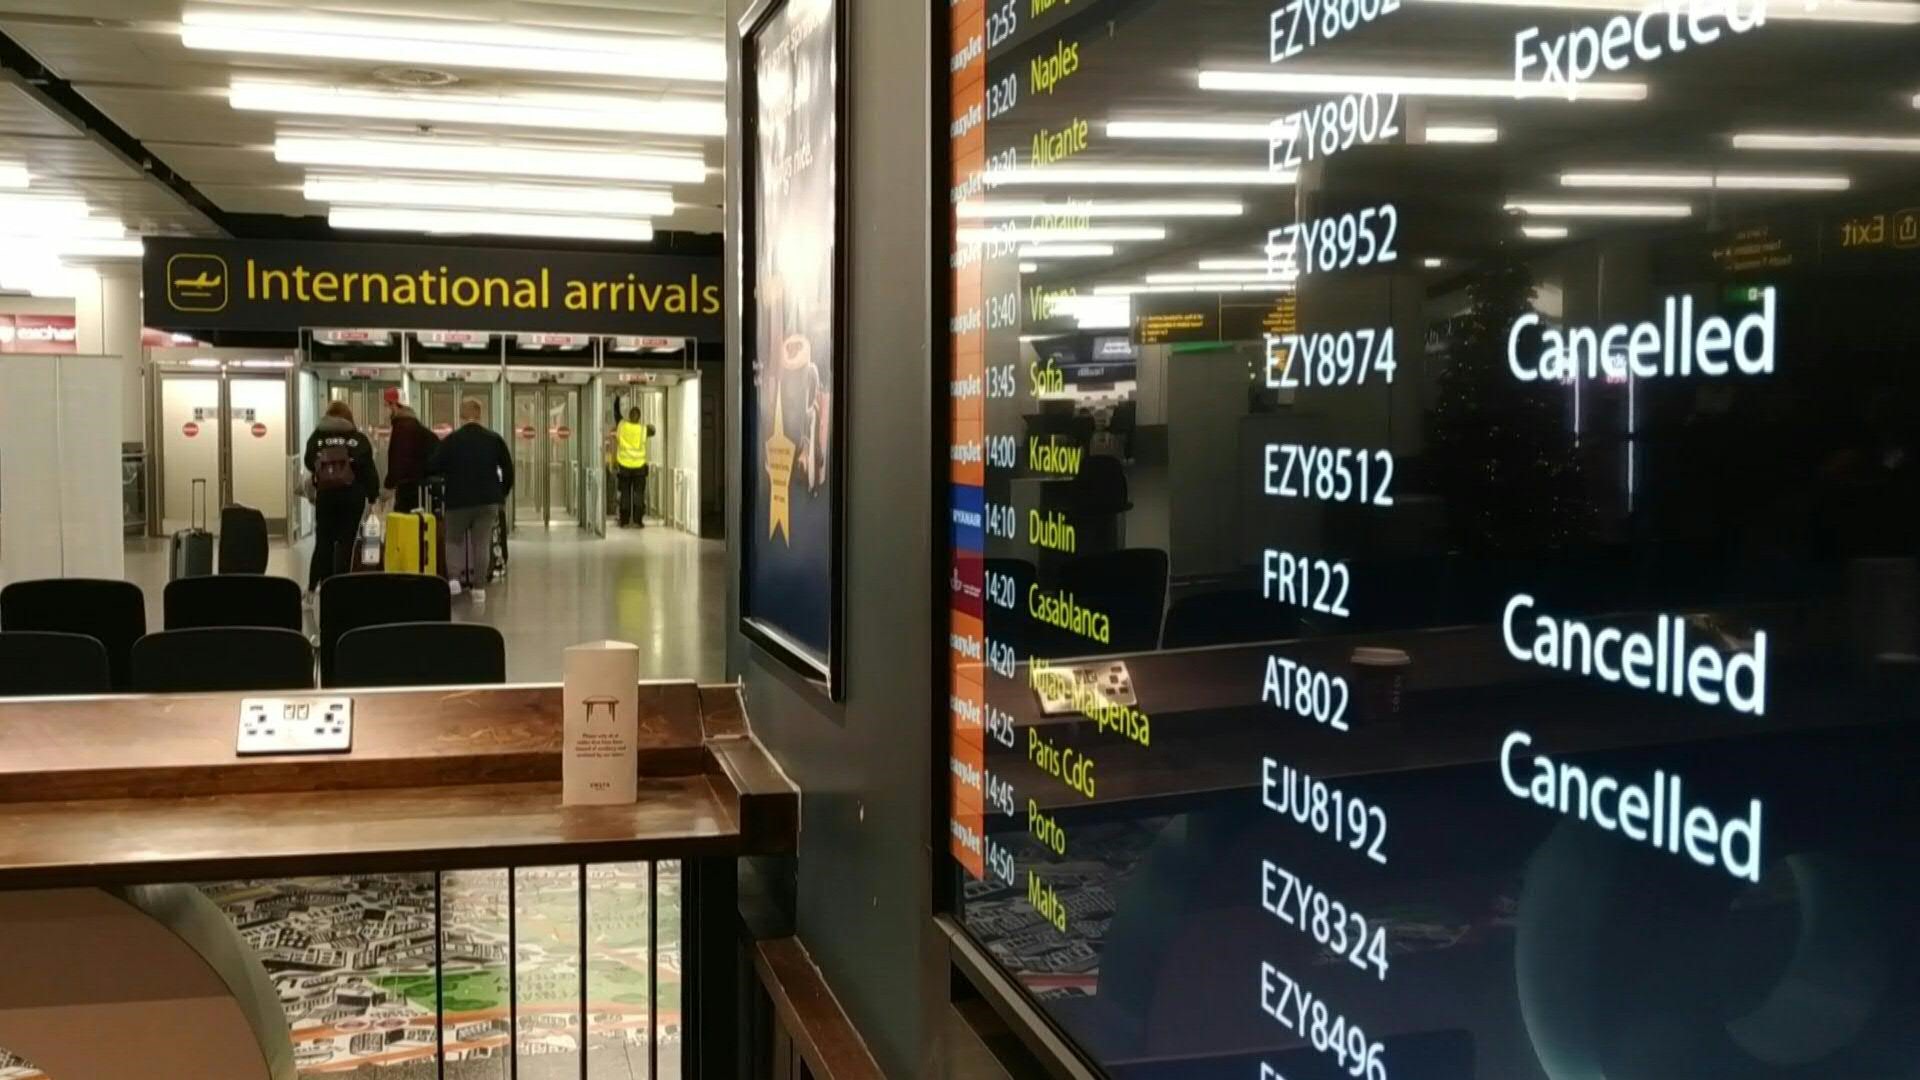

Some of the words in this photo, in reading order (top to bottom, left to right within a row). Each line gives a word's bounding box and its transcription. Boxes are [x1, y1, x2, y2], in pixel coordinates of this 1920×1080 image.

[1269, 0, 1401, 64] EZY86
[1031, 40, 1079, 95] Naples
[986, 73, 1018, 120] 13:20
[1031, 118, 1088, 168] Alicante
[1269, 86, 1400, 174] EZY8902
[1265, 204, 1398, 281] EZY8952
[246, 259, 549, 309] International
[565, 273, 721, 315] arrivals
[985, 293, 1016, 329] 13:40
[1263, 326, 1397, 388] EZY8974
[1507, 286, 1776, 382] Cancelled
[985, 365, 1016, 399] 13:45
[1030, 358, 1065, 397] Sofia
[985, 435, 1016, 468] 14:00
[1030, 435, 1082, 473] Krakow
[1264, 443, 1394, 506] EZY8512
[985, 502, 1016, 540] 14:10
[1029, 509, 1076, 554] Dublin
[985, 569, 1016, 610] 14:20
[1263, 548, 1350, 618] FR122
[1029, 582, 1110, 645] Casablanca
[985, 636, 1016, 679] 14:20
[1502, 593, 1767, 717] Cancelled
[1262, 654, 1349, 732] AT802
[984, 702, 1015, 748] 14:25
[1029, 727, 1060, 777] Paris
[1062, 748, 1095, 799] CdG
[984, 769, 1015, 818] 14:45
[1262, 756, 1388, 865] EJU8192
[1499, 730, 1761, 883] Cancelled
[1029, 799, 1066, 855] Porto
[984, 835, 1015, 887] 14:50
[1029, 869, 1067, 933] Malta
[1261, 858, 1390, 982] EZY8324
[1260, 960, 1388, 1080] EZY8496
